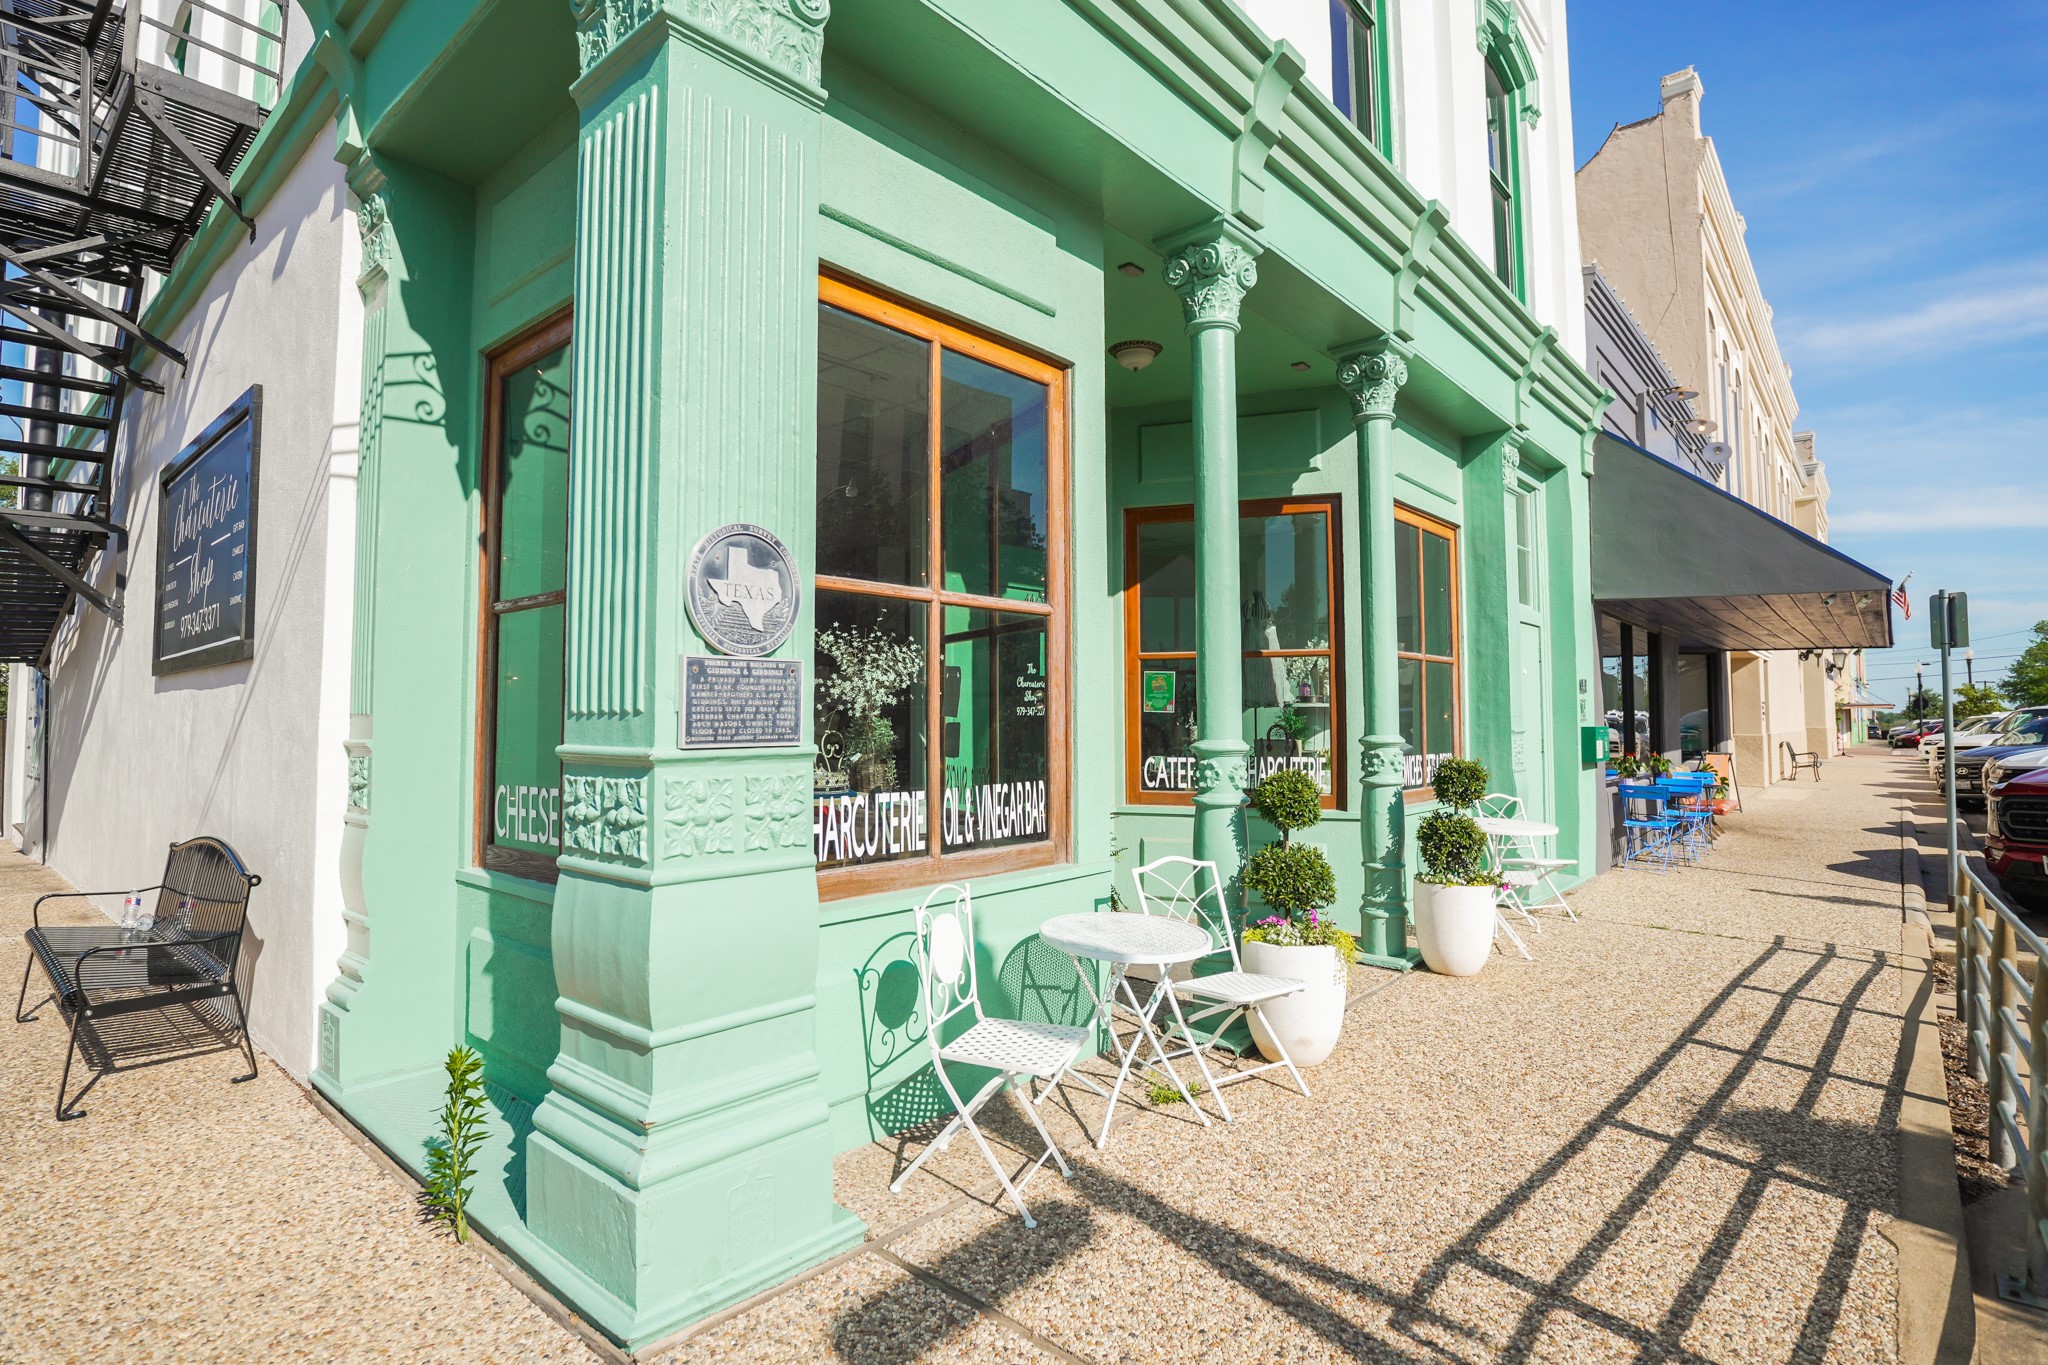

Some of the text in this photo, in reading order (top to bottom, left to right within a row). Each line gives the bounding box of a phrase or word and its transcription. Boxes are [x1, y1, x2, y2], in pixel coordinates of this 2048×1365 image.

[173, 474, 239, 552] Charcuterie
[703, 524, 744, 549] HISTORICAL
[748, 525, 778, 543] SURVEY
[187, 535, 214, 609] Shop
[723, 583, 774, 601] TEXAS
[722, 642, 762, 654] HISTORICAL
[1143, 756, 1199, 789] CATER
[494, 784, 560, 847] CHEESE
[813, 779, 1046, 862] HARCUTERIE OIL & VINEGAR BAR
